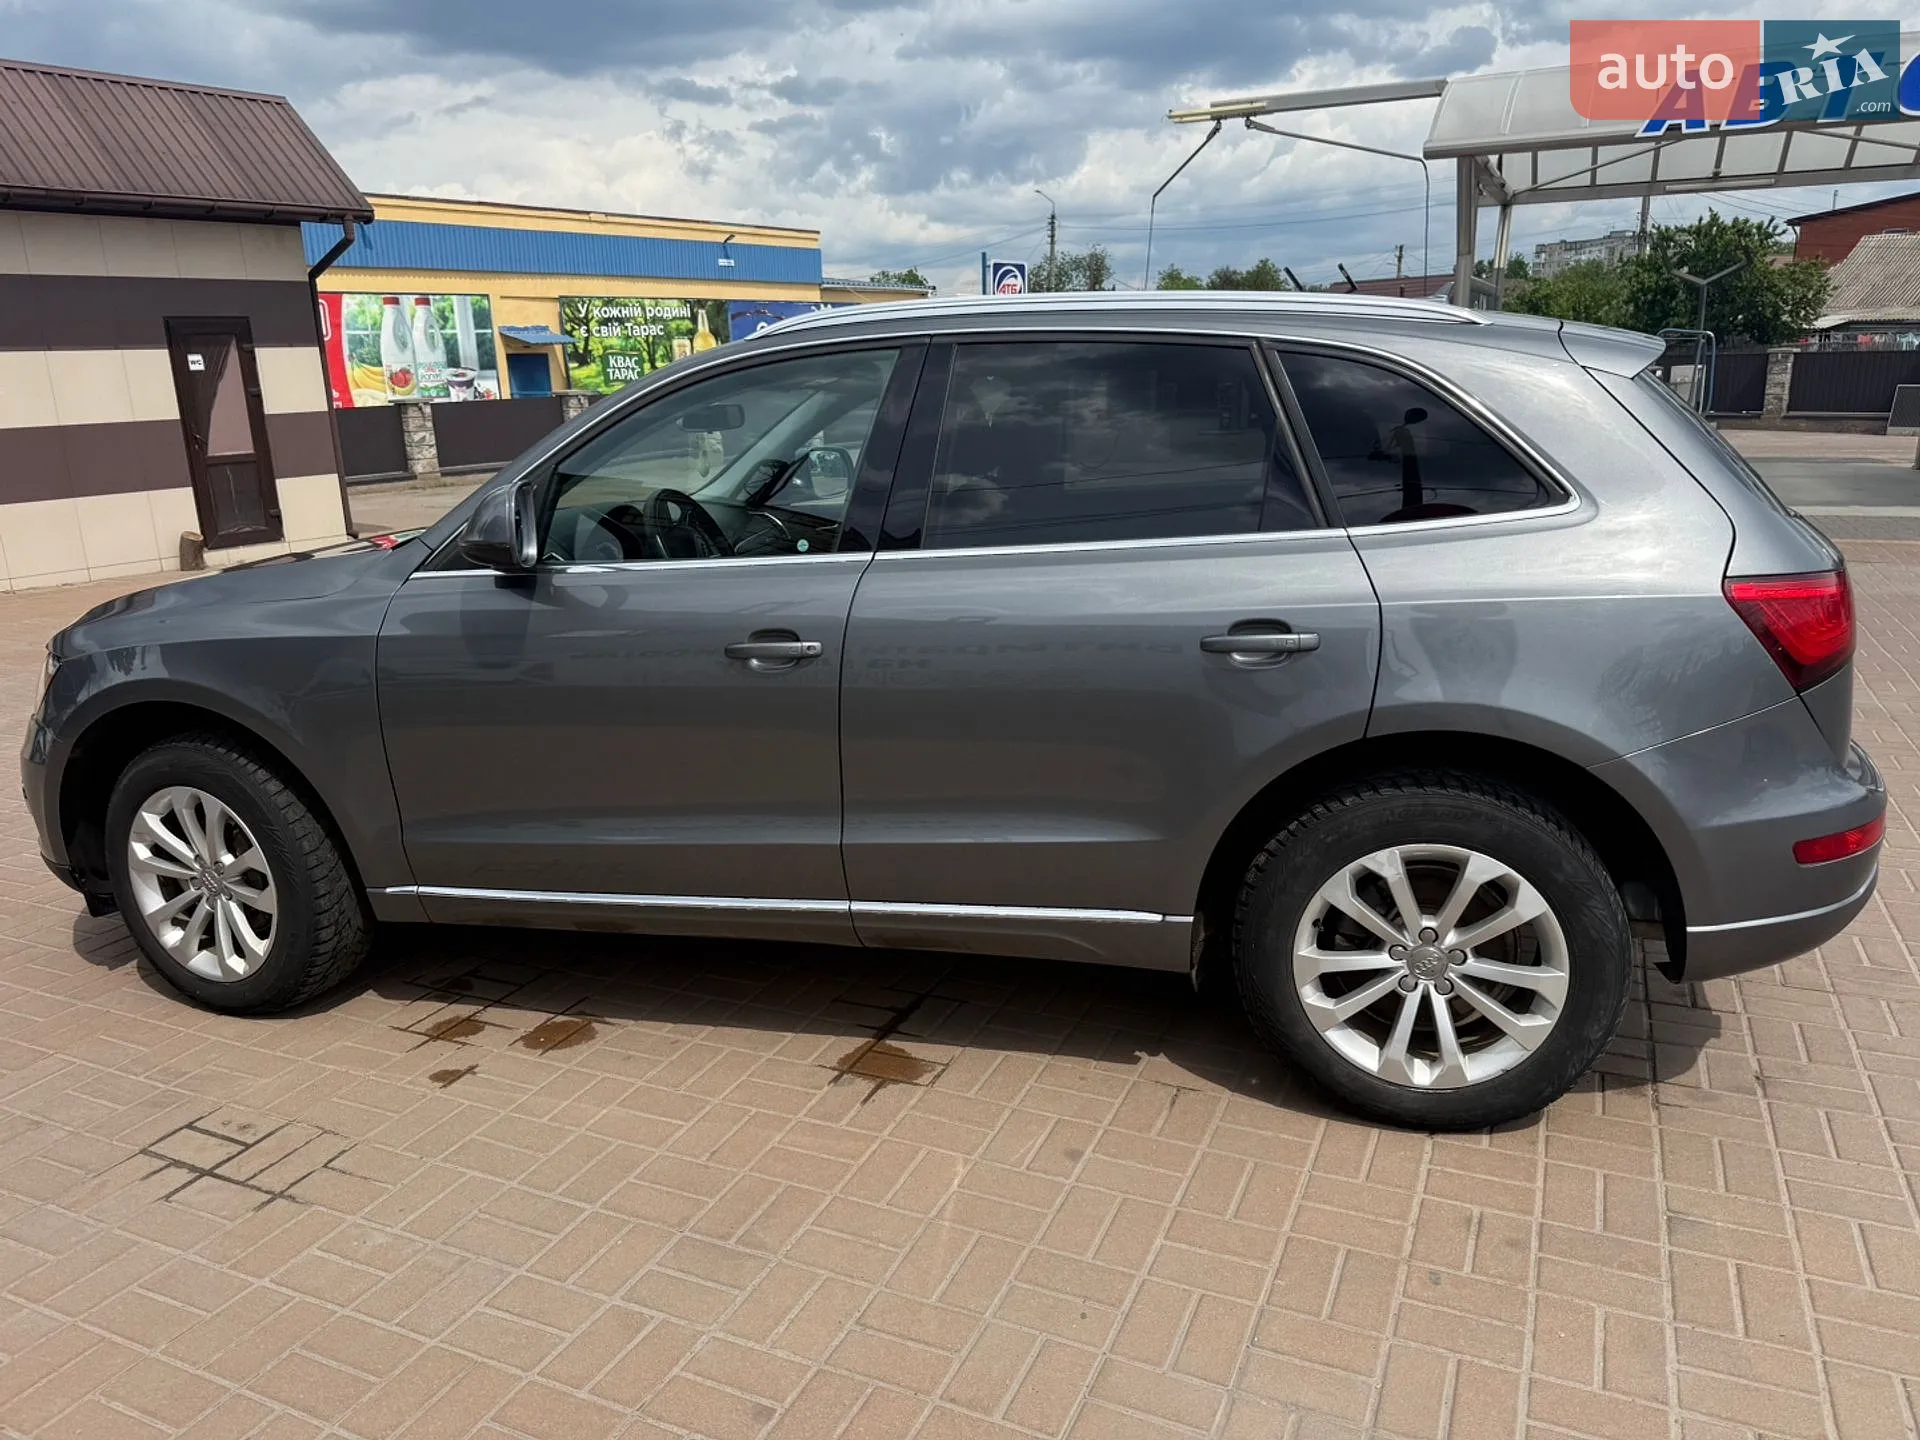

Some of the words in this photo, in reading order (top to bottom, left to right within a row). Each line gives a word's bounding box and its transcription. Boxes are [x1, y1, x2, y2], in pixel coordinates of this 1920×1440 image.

[577, 303, 588, 318] У
[593, 303, 642, 318] кожній
[646, 304, 691, 320] родині
[592, 323, 621, 337] свій
[624, 323, 665, 337] Тарас
[608, 355, 639, 369] КВАС
[606, 367, 641, 380] ТАРАС
